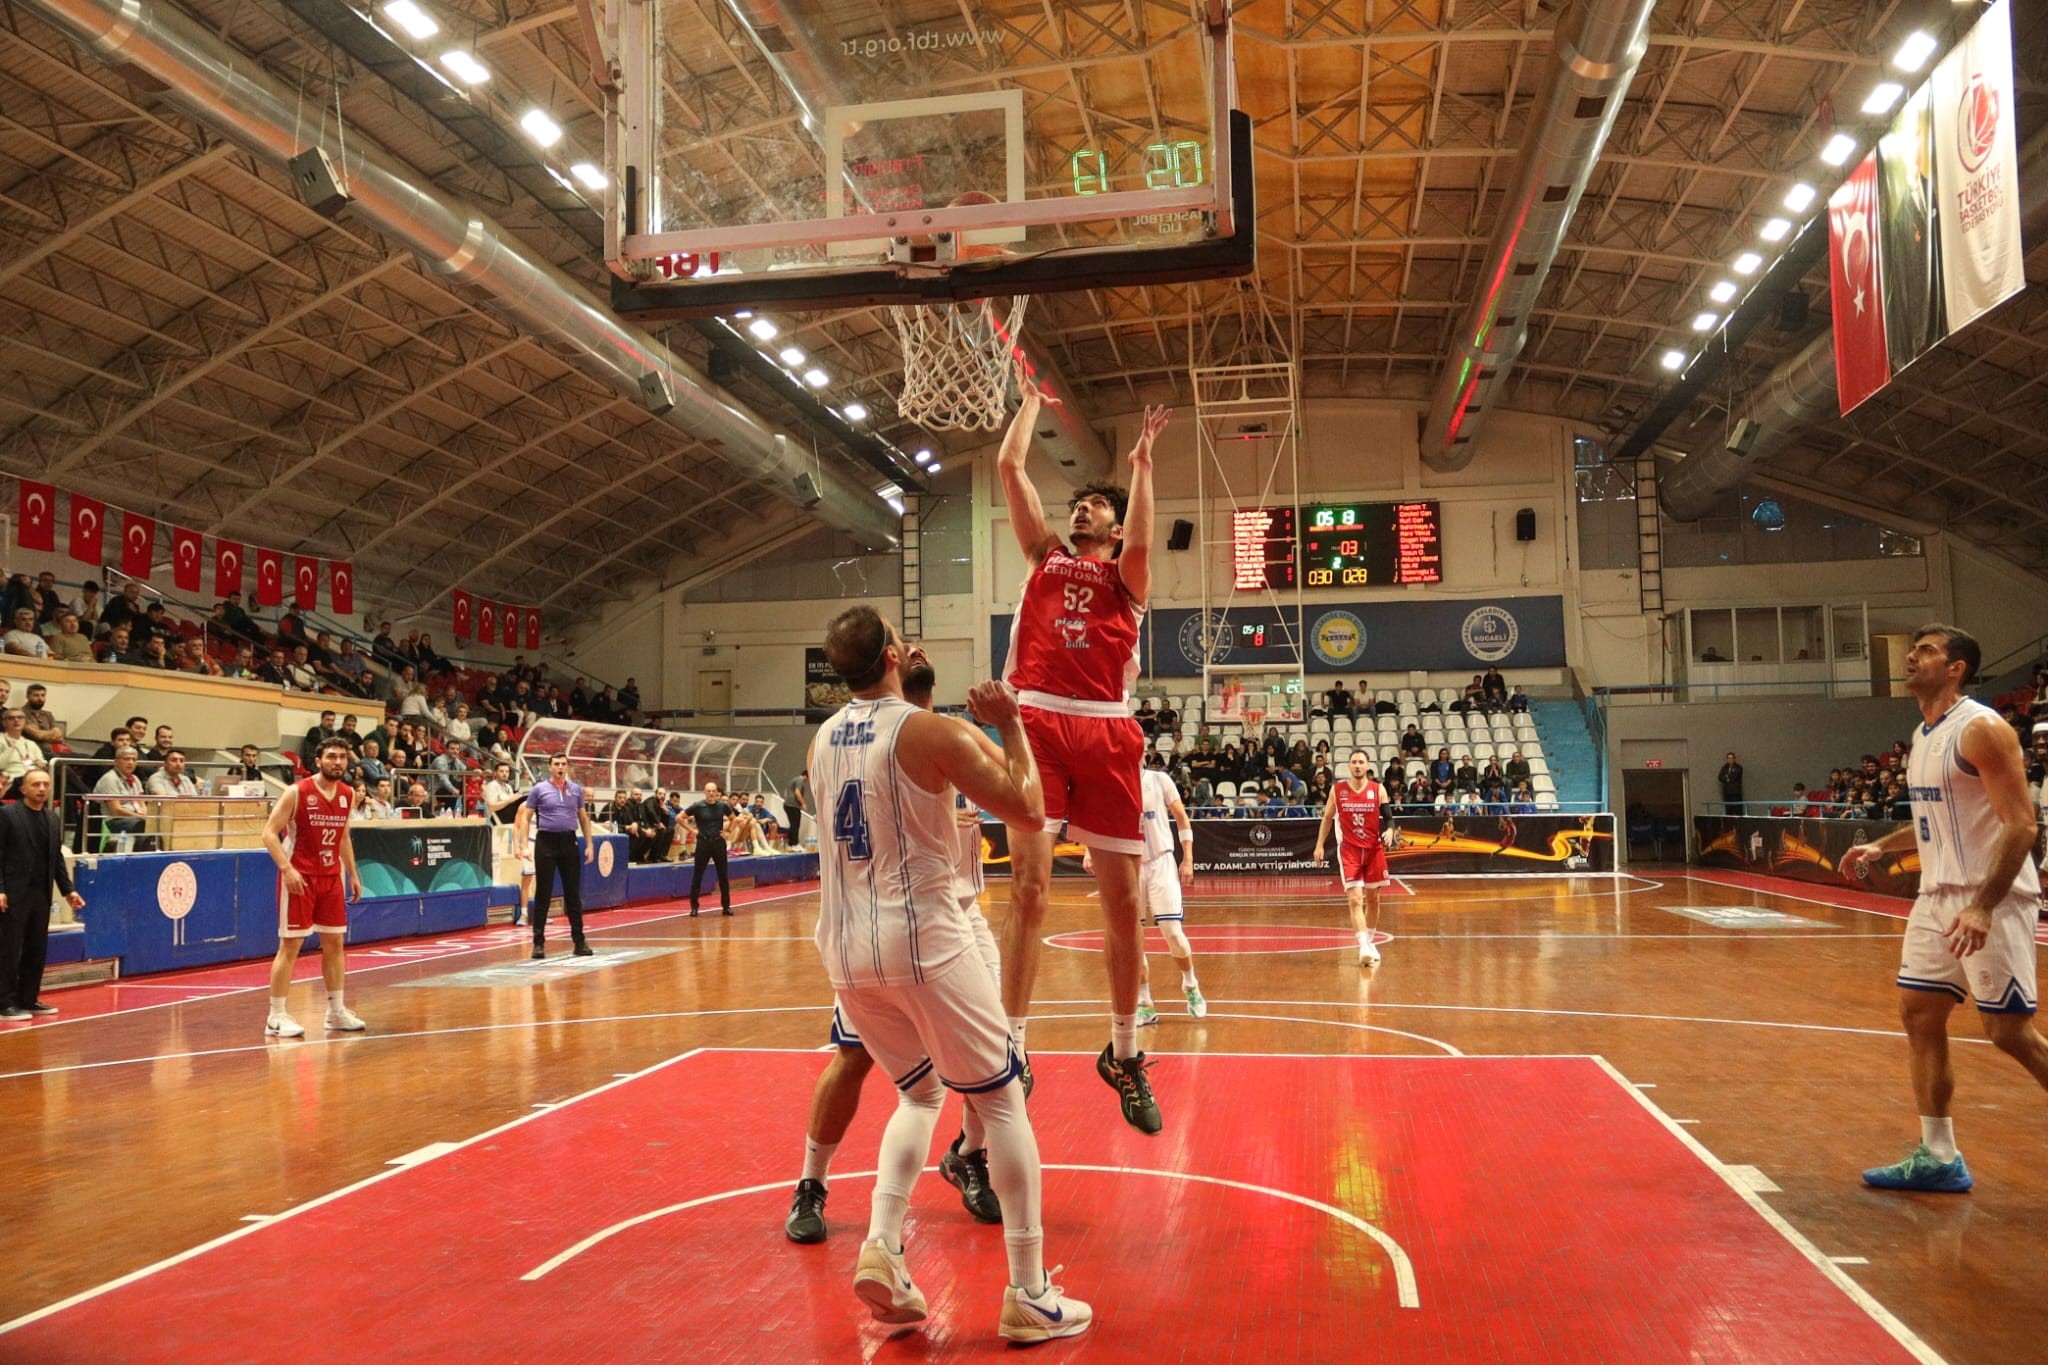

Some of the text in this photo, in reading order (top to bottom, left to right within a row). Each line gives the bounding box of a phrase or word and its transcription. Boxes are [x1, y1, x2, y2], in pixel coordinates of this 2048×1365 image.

[1316, 510, 1334, 526] 05
[1341, 540, 1358, 555] 03
[1332, 557, 1341, 569] 2
[1308, 568, 1367, 585] 030 028
[1063, 583, 1094, 613] 52
[1473, 633, 1507, 642] KOCAELİ
[834, 779, 872, 861] 4
[1352, 813, 1365, 826] 35
[1919, 815, 1930, 842] 5
[321, 828, 337, 846] 22
[1213, 862, 1257, 870] ADAMLAR
